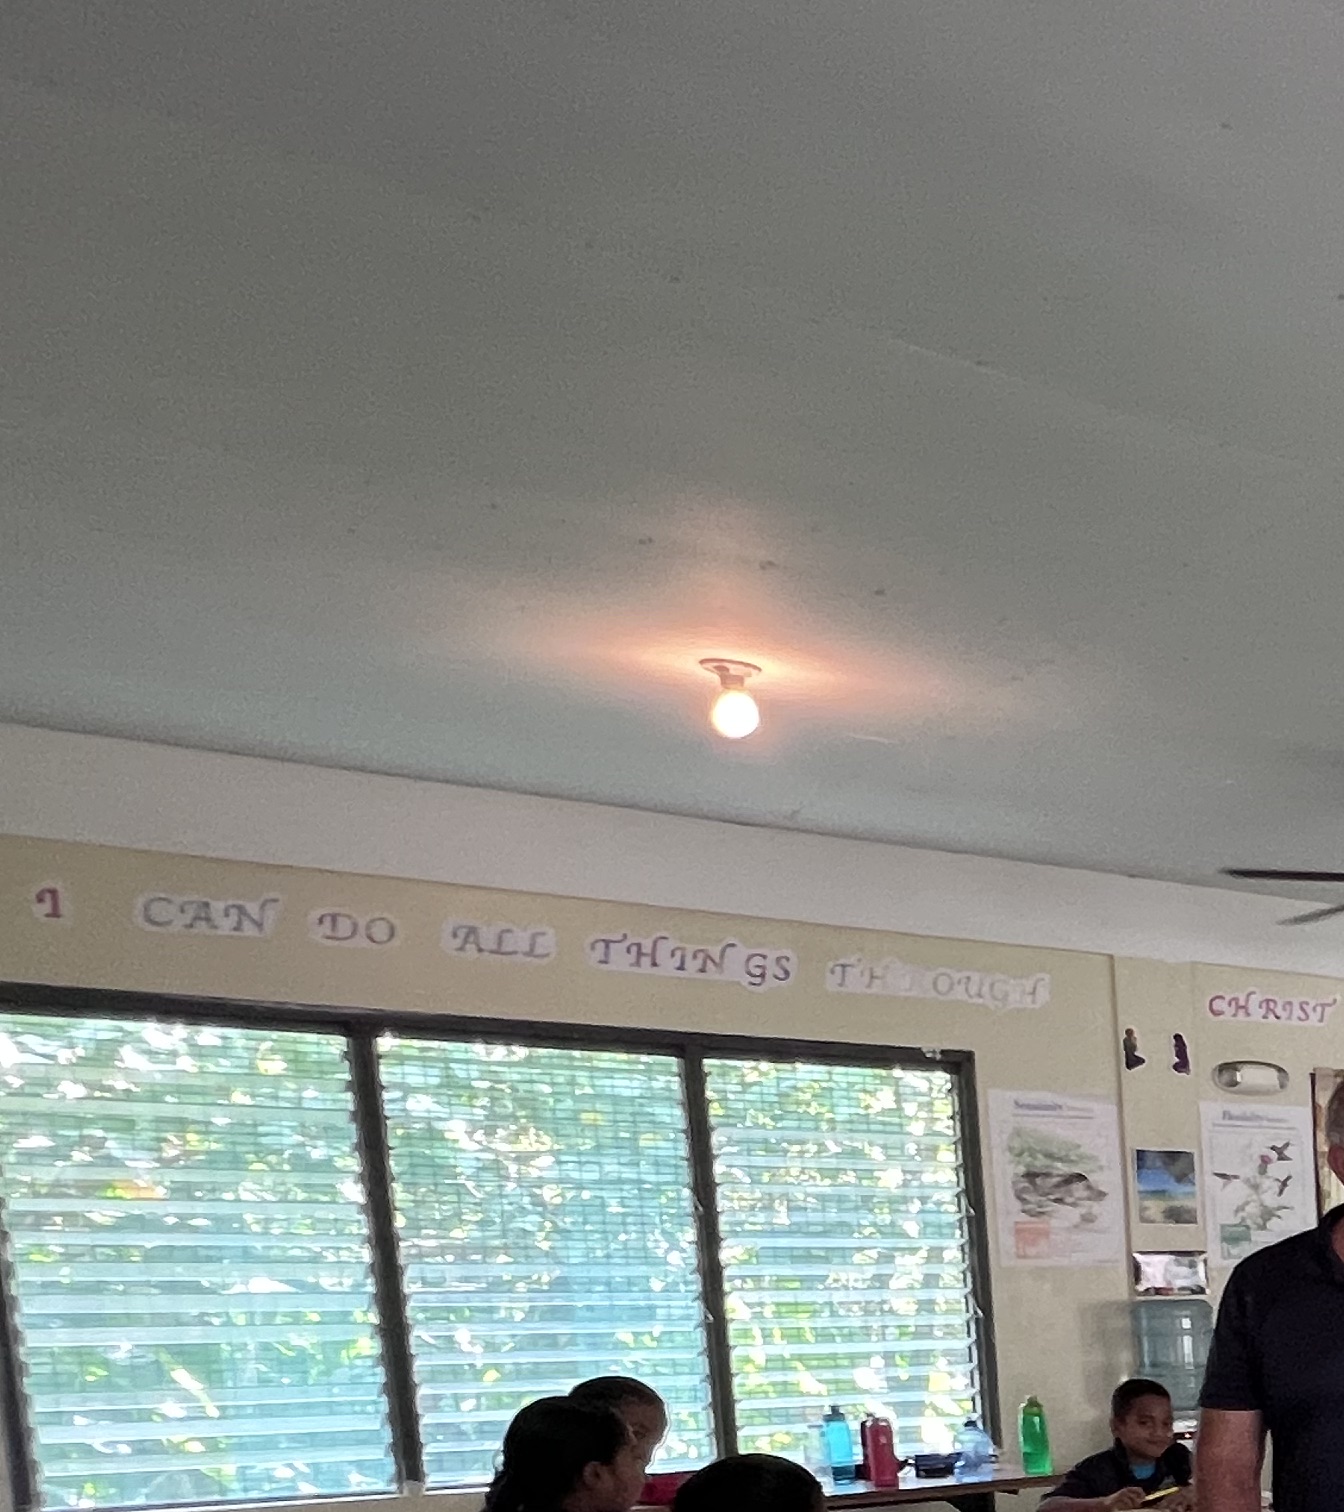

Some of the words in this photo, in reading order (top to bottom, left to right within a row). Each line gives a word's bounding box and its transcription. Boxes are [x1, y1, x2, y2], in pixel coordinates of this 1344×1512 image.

[143, 897, 280, 933] CAN
[317, 912, 396, 945] DO
[452, 924, 551, 958] ALL
[591, 932, 793, 988] THINGS
[1208, 991, 1338, 1024] CHRIST
